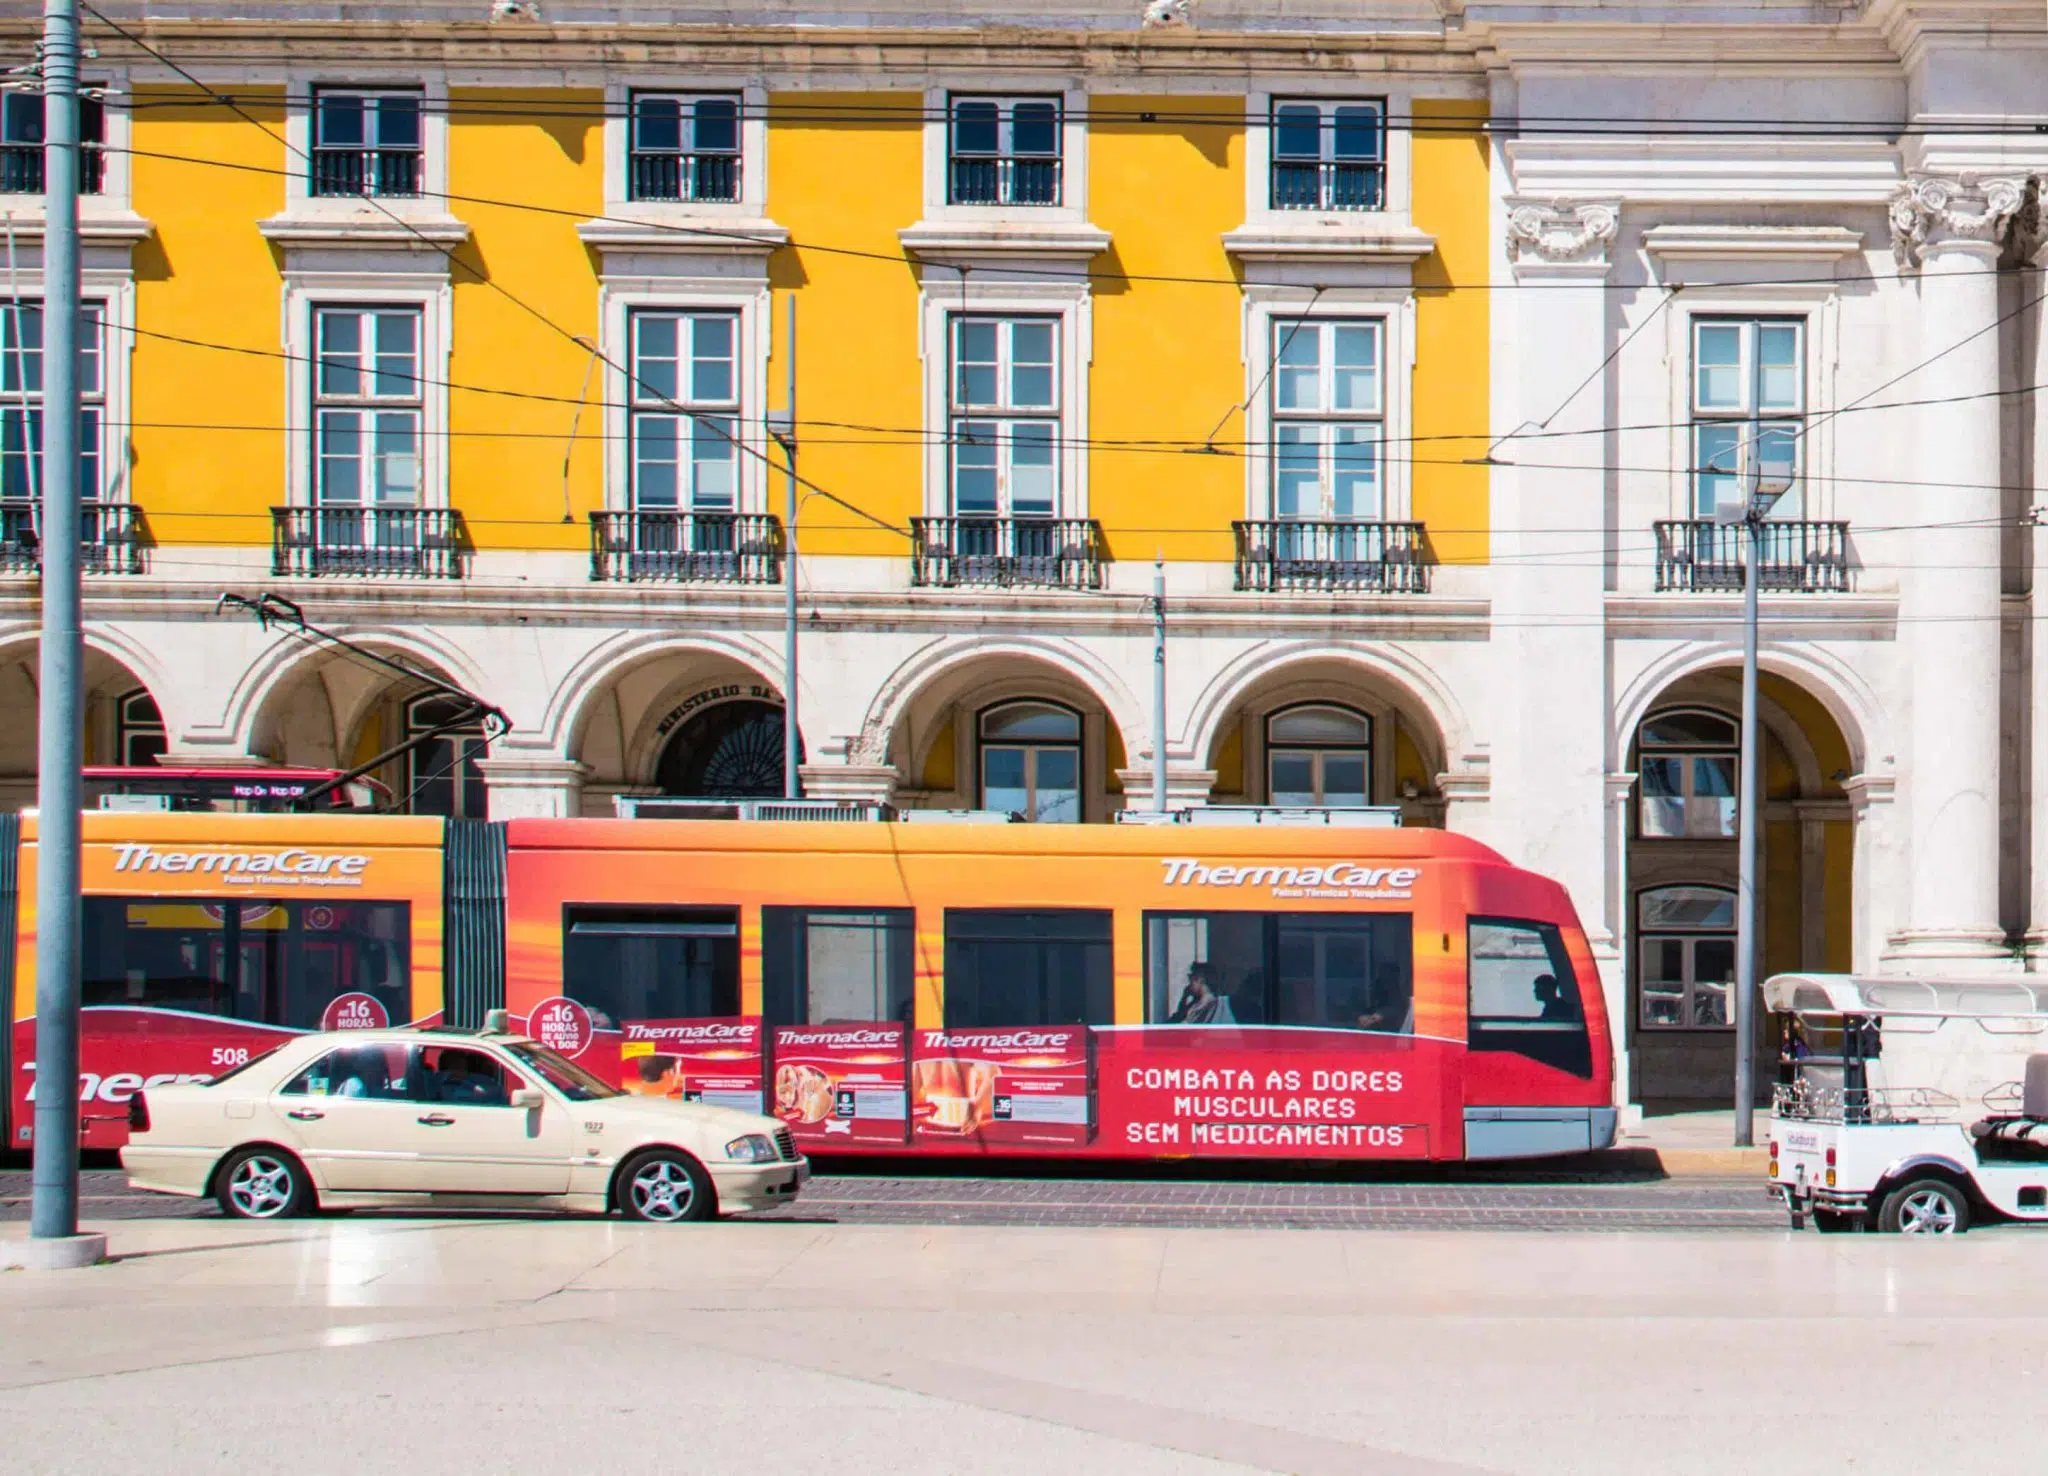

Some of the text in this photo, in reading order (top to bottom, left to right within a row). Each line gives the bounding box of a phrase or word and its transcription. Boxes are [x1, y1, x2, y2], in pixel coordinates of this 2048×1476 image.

[111, 843, 368, 874] ThermaCare
[1160, 857, 1417, 888] ThermaCare
[347, 1000, 370, 1018] 16
[551, 1004, 574, 1022] 16
[337, 1018, 375, 1028] HORAS
[541, 1022, 578, 1032] HORAS
[627, 1023, 754, 1039] ThermaCare
[557, 1040, 578, 1050] DOR
[778, 1029, 900, 1044] ThermaCare
[924, 1031, 1068, 1048] ThermaCare
[211, 1048, 249, 1065] 508
[1126, 1068, 1403, 1092] COMBATA AS DORES
[1174, 1096, 1356, 1119] MUSCULARES
[1126, 1122, 1404, 1147] SEM MEDICAMENTOS
